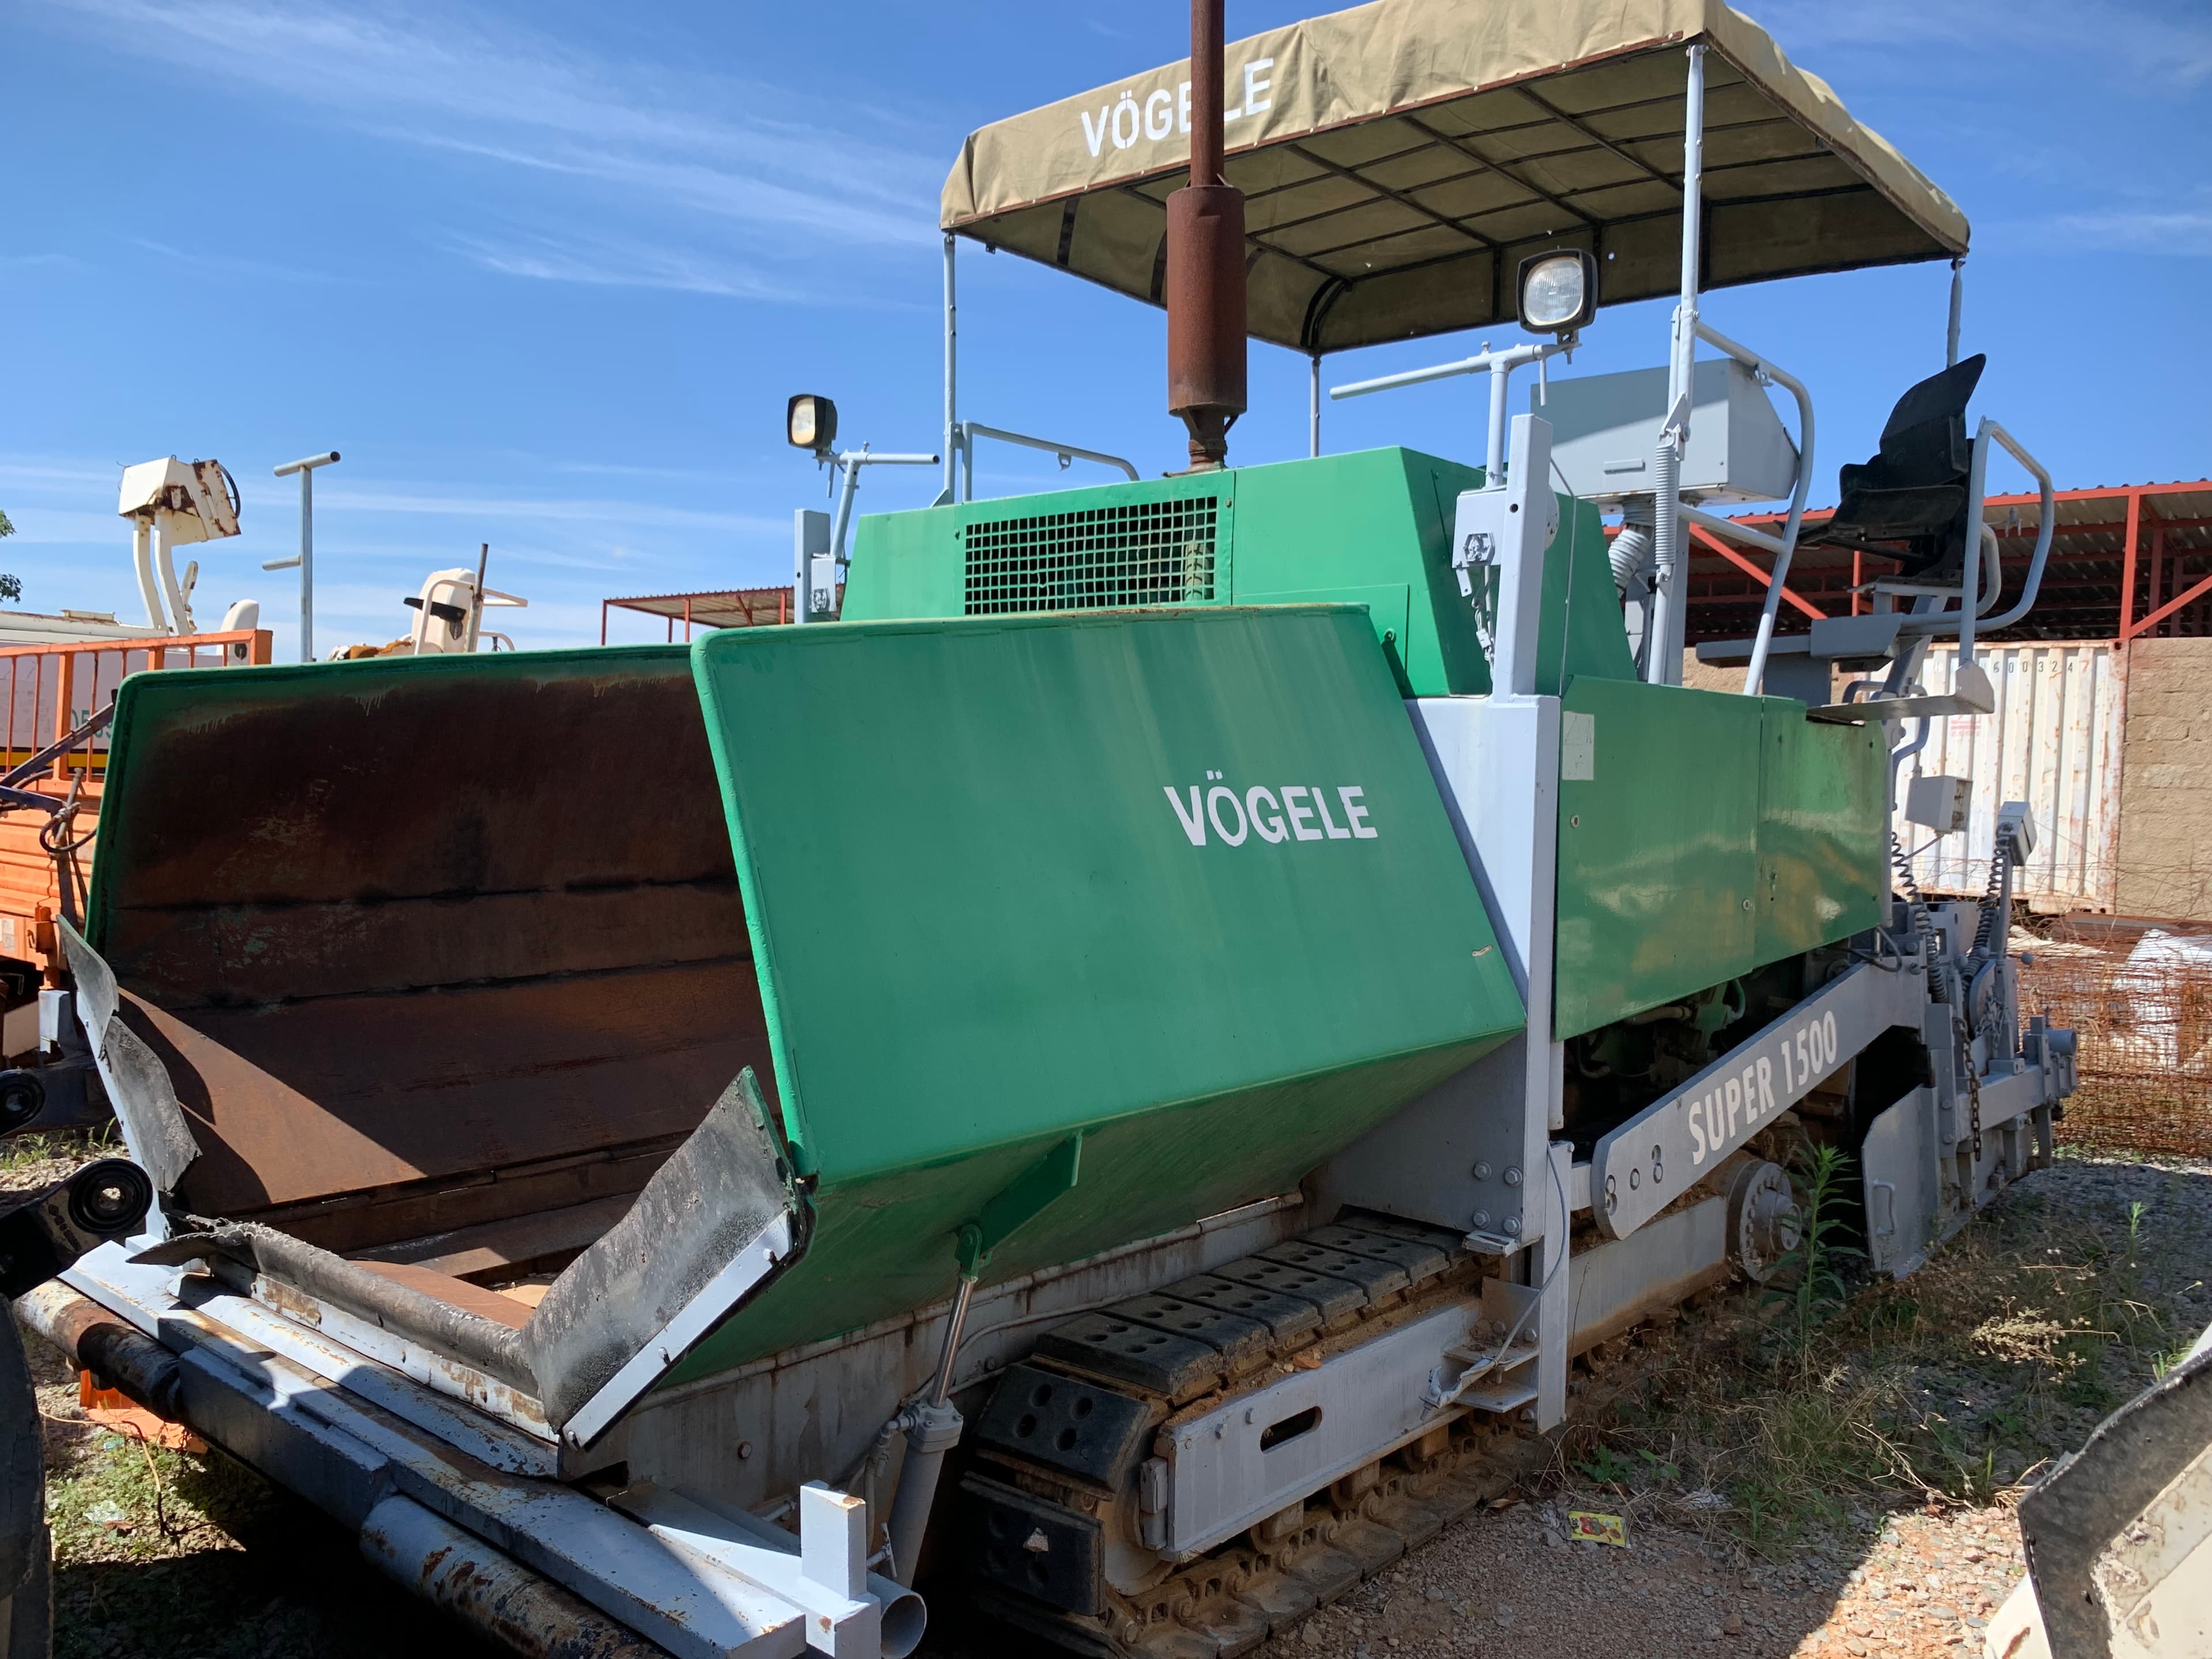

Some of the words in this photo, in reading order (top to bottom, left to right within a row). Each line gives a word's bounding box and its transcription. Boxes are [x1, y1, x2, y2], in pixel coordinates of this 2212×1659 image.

[1993, 661, 2090, 673] 6003247
[1162, 769, 1378, 847] VÖGELE
[1688, 1056, 1775, 1165] SUPER
[1781, 1010, 1836, 1094] 1500
